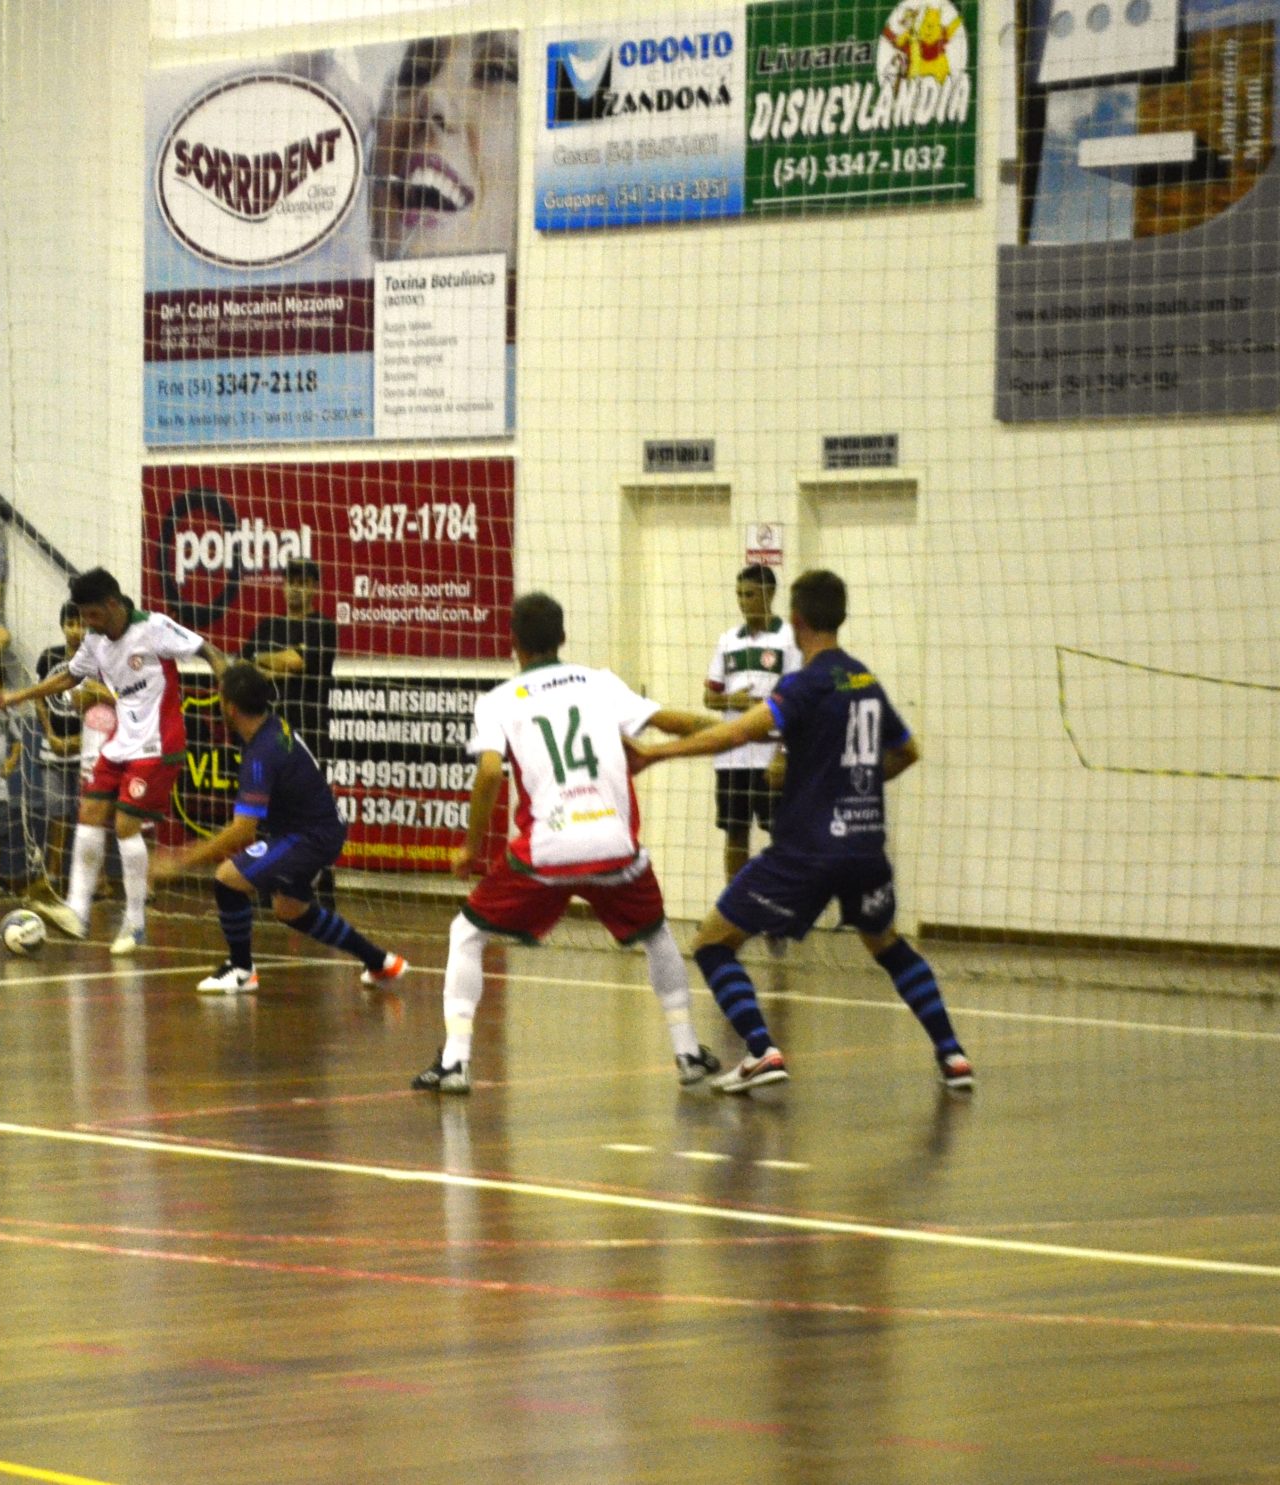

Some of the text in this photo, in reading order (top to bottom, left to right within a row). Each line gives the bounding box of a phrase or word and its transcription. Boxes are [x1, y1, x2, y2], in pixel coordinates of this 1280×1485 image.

[619, 31, 733, 66] ODONTO
[756, 36, 872, 74] Livraria
[603, 76, 732, 116] ZANDONÁ
[749, 70, 970, 142] DISNEYLANDIA
[174, 128, 342, 216] SORRIDENT
[774, 145, 946, 188] (54) 3347-1032
[385, 273, 427, 292] Toxina
[188, 302, 219, 318] Carla
[223, 297, 282, 316] Maccarini
[285, 296, 345, 312] Mezzomo
[158, 368, 318, 397] Fone (54) 3347-2118
[349, 502, 477, 542] 3347-1784
[175, 517, 312, 585] porthal
[532, 705, 599, 784] 14
[840, 698, 881, 767] 10
